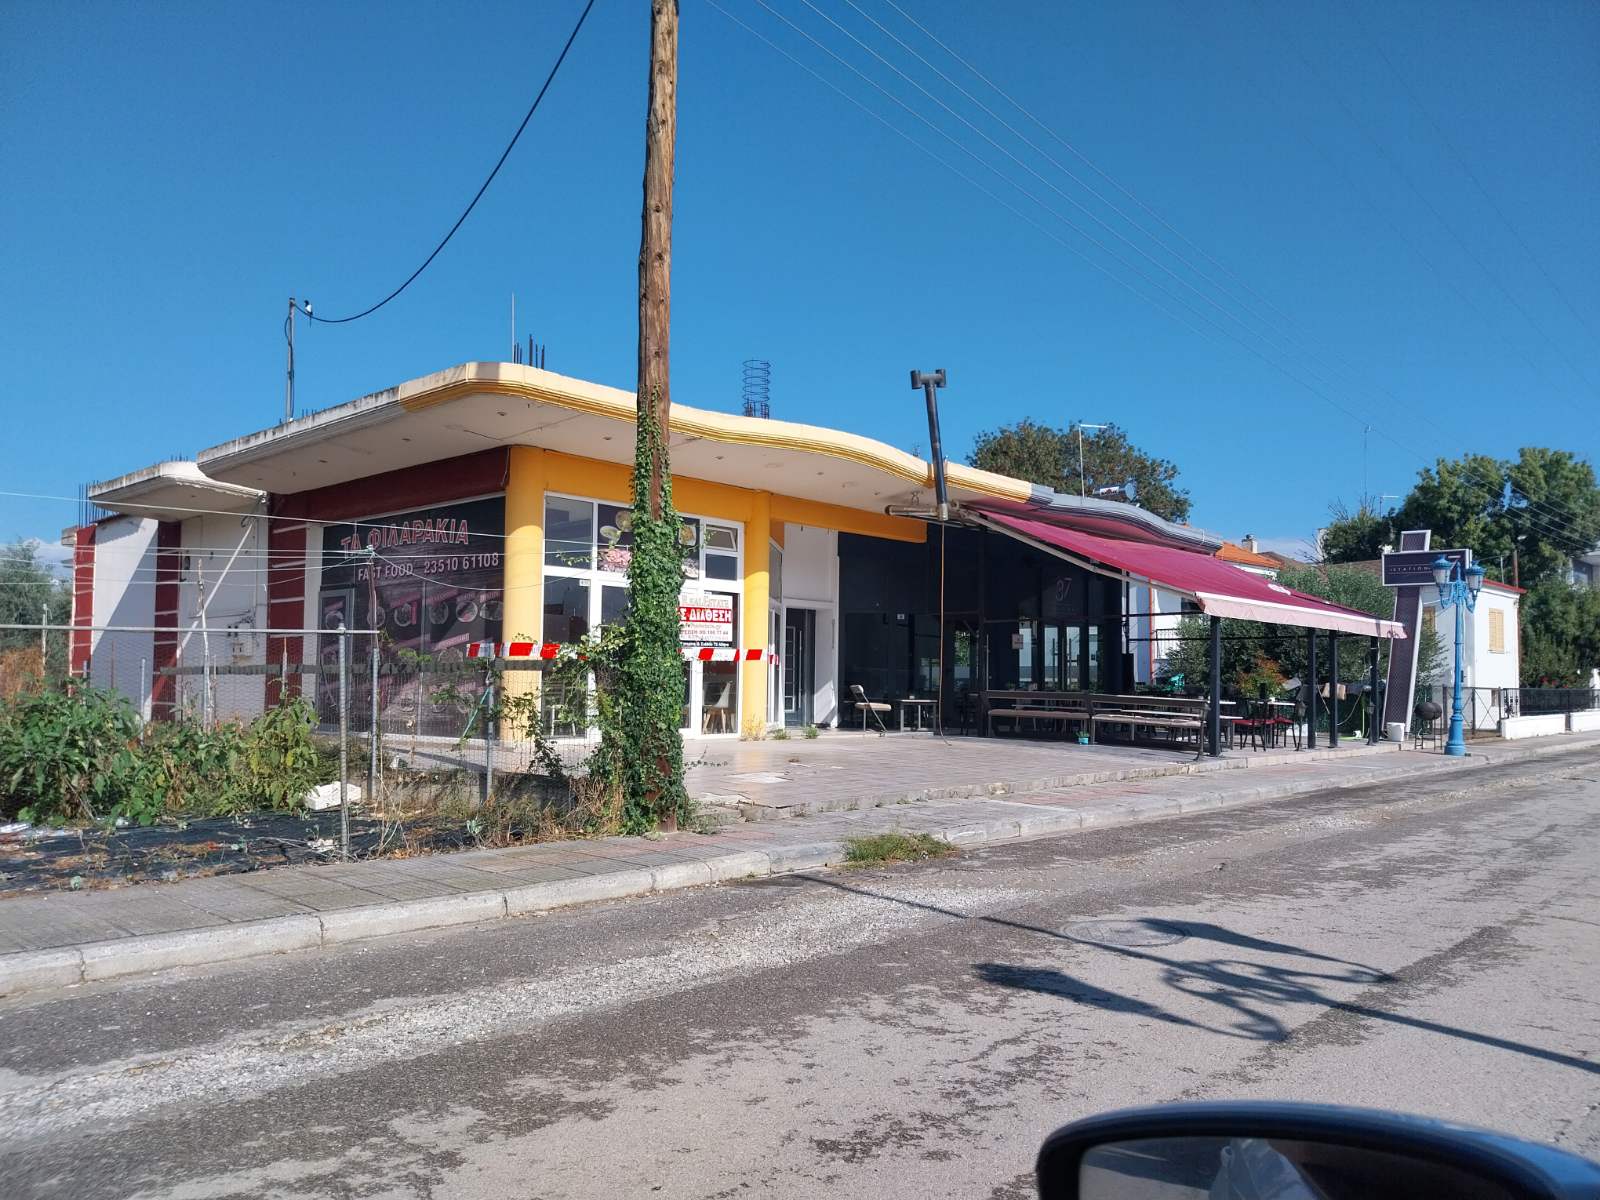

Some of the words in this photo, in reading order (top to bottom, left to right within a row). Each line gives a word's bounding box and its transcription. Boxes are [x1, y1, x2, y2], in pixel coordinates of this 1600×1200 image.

[341, 533, 362, 559] ΤΑ
[368, 518, 469, 550] ΦΙΛΑΡΑΚΙΑ
[385, 563, 414, 578] FOOD
[424, 557, 459, 574] 23510
[462, 552, 499, 570] 61108
[689, 608, 732, 622] ΔΙΑΘΕΣΗ
